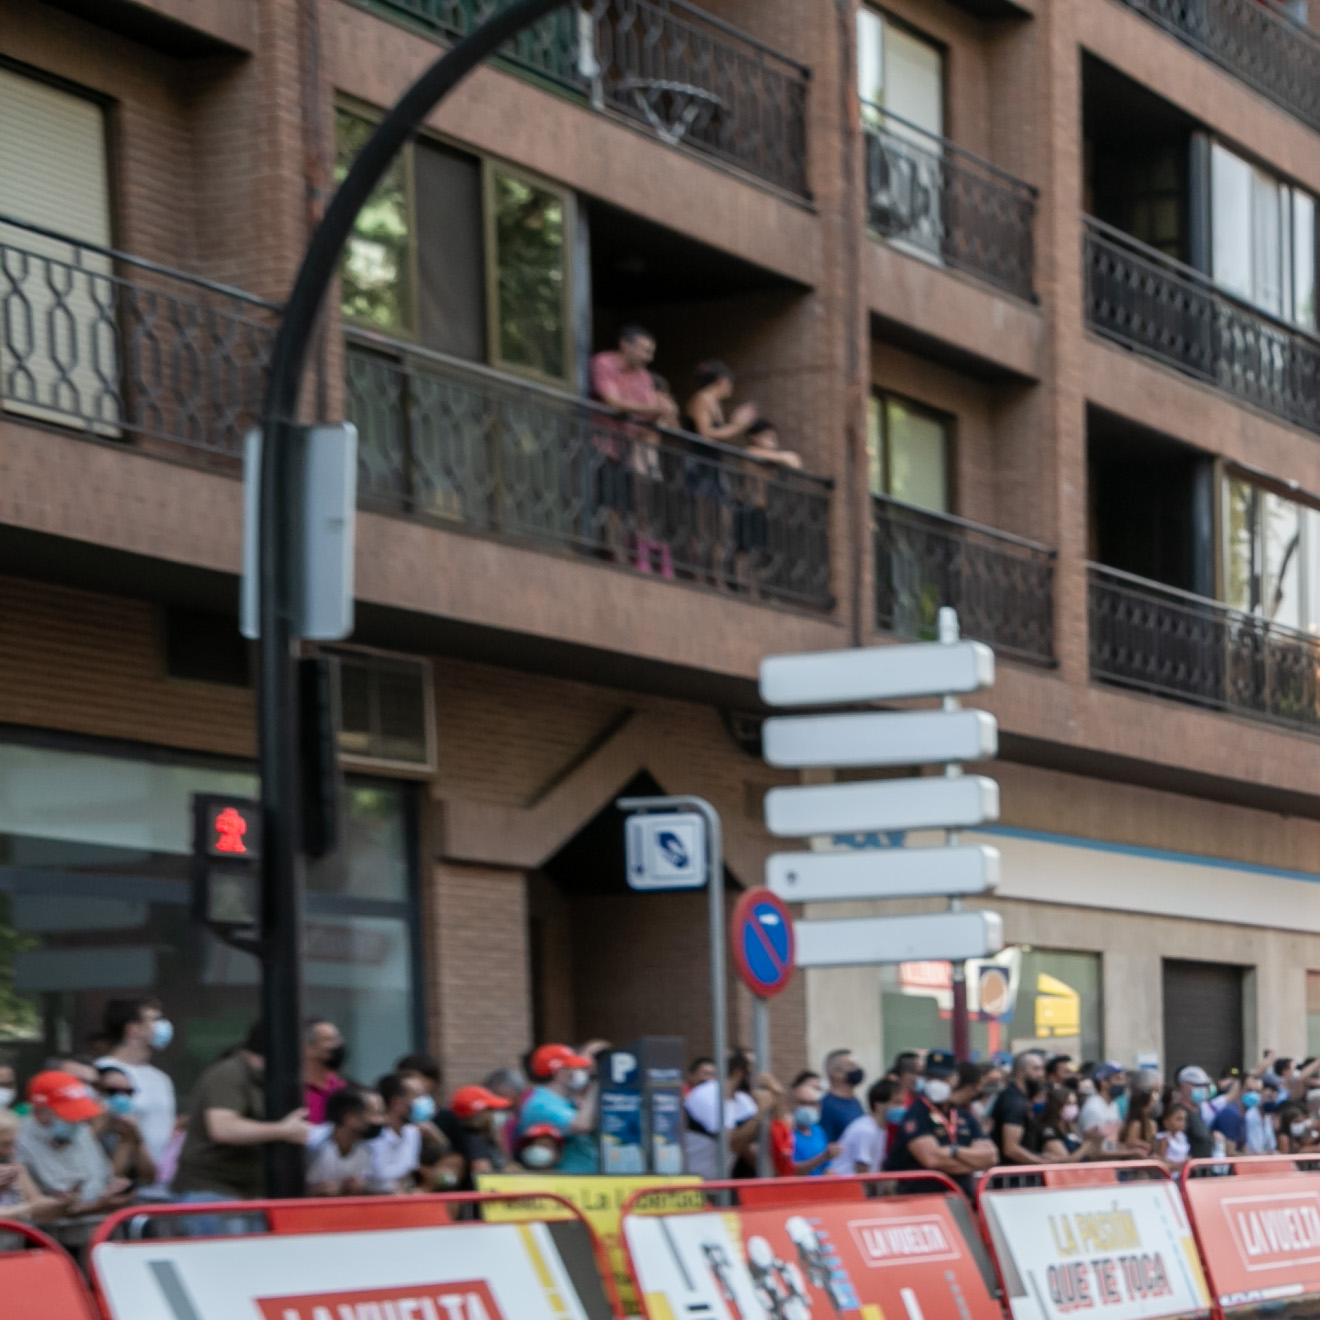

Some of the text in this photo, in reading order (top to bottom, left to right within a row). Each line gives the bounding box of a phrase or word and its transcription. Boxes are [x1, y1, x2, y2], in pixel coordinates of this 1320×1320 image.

[610, 1052, 638, 1084] P
[1050, 1214, 1081, 1258] LA
[1237, 1210, 1270, 1256] LA
[1046, 1261, 1094, 1314] QUE
[1091, 1258, 1123, 1308] TE
[1118, 1251, 1174, 1302] TOCA
